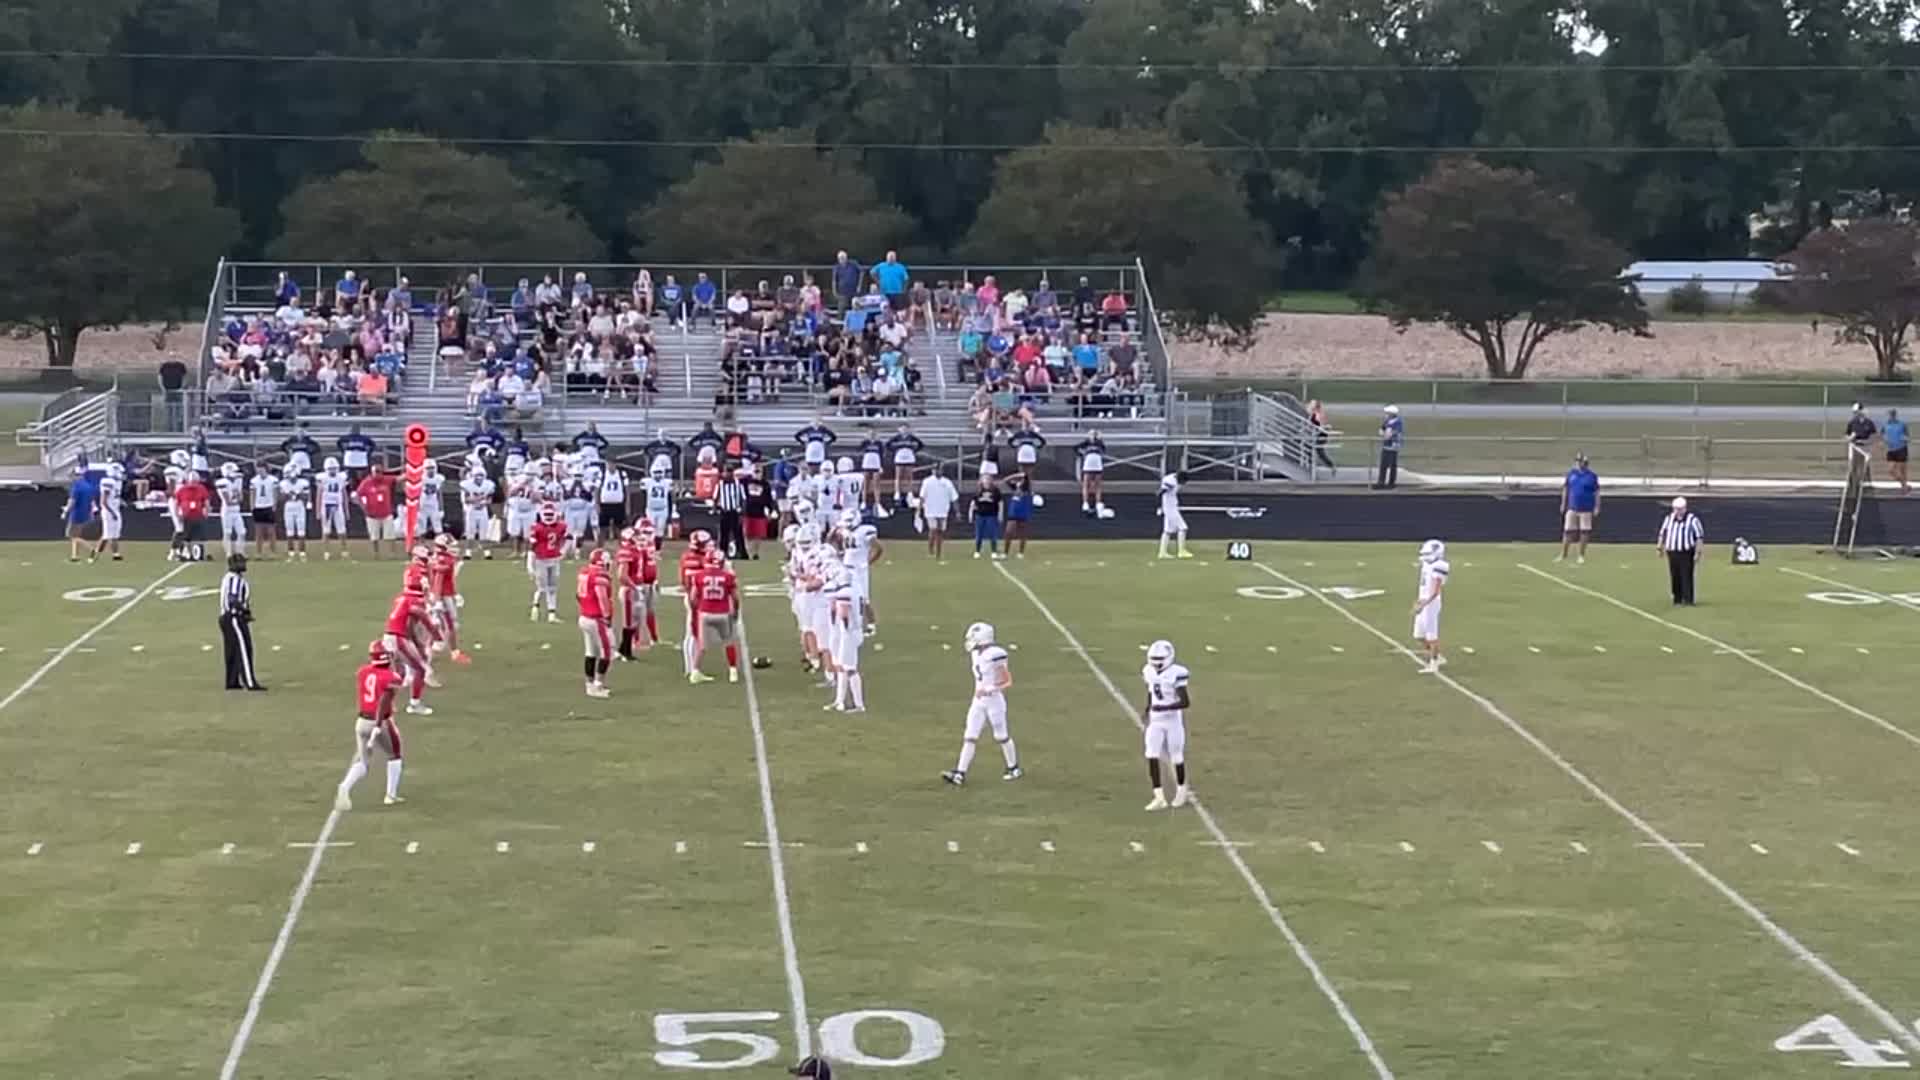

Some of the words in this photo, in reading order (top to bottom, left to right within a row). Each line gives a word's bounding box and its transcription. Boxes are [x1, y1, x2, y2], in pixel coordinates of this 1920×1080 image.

[547, 532, 557, 550] 2
[1229, 542, 1250, 559] 40
[1736, 545, 1756, 562] 30
[701, 575, 726, 600] 25
[364, 673, 377, 703] 9
[653, 1009, 946, 1069] 50
[1774, 1013, 1920, 1069] 4
